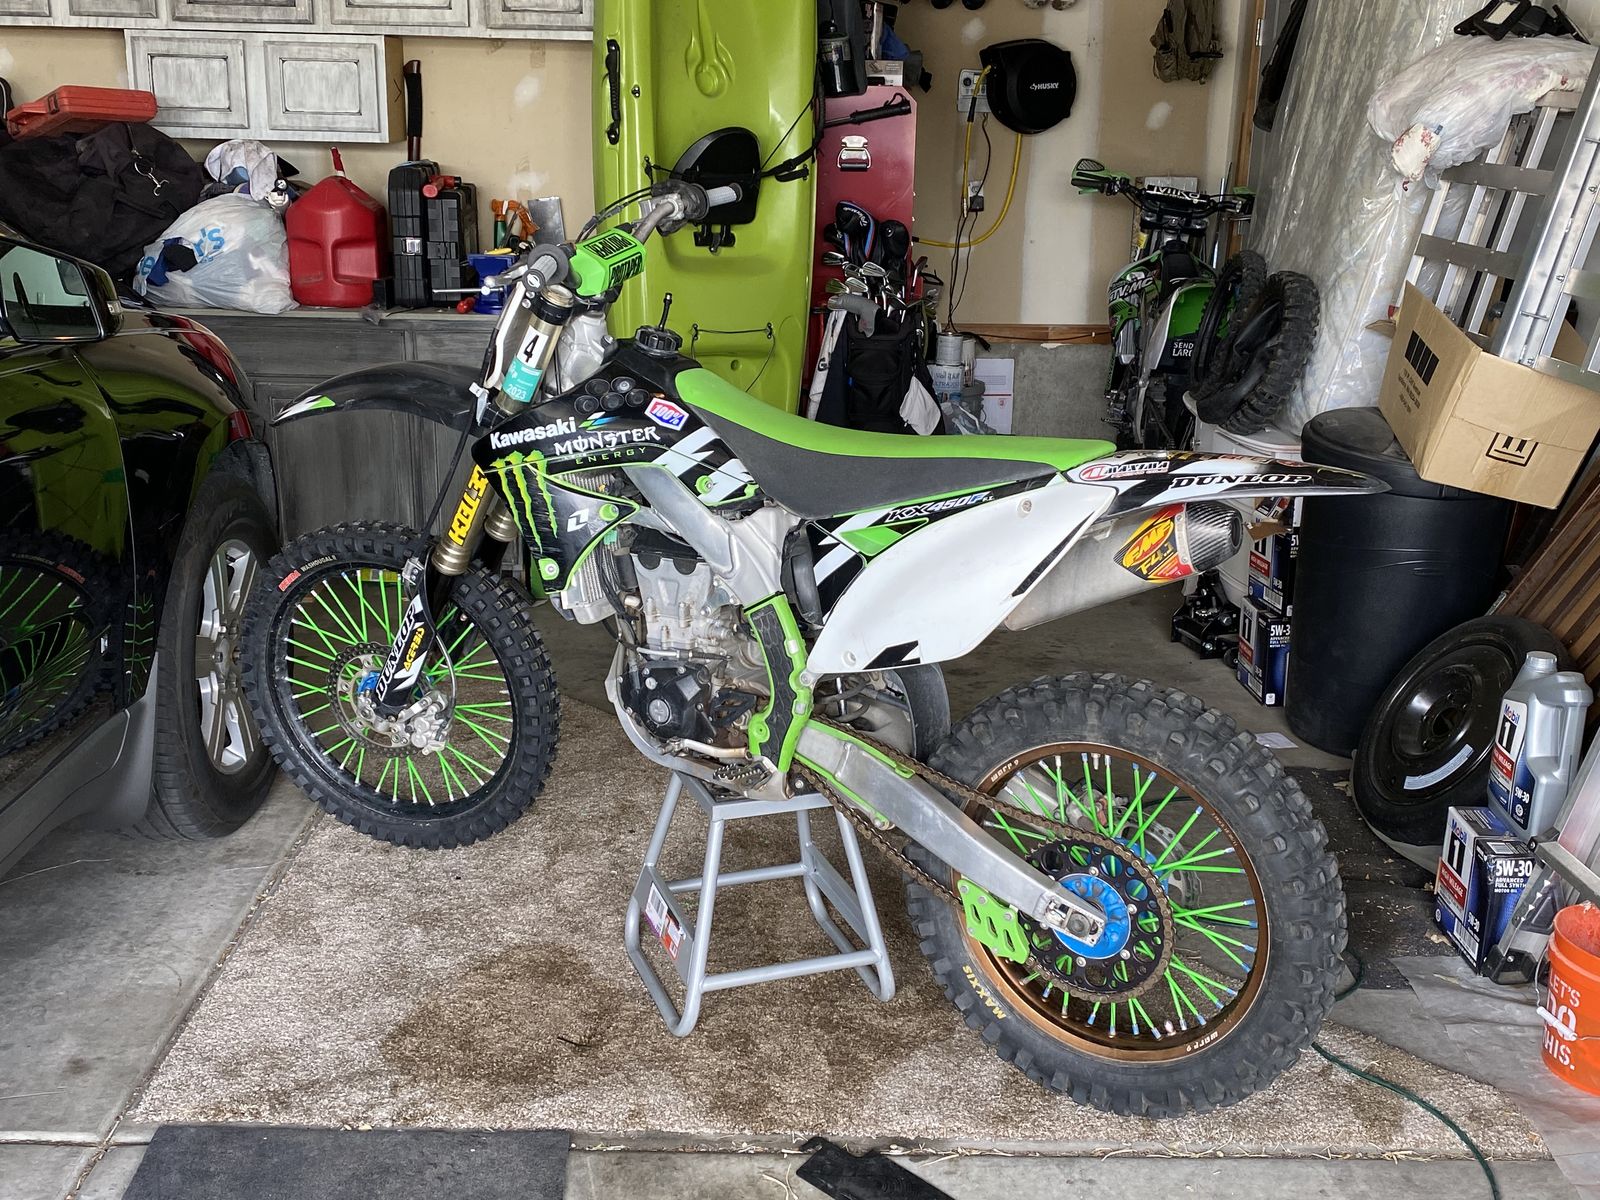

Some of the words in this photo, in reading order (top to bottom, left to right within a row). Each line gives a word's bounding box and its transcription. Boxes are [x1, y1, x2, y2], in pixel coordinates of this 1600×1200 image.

[1037, 82, 1059, 90] HUSKY
[523, 334, 540, 363] 4
[1173, 341, 1194, 349] SEND
[507, 384, 527, 400] 2023
[652, 403, 684, 426] 100%
[490, 416, 577, 450] Kawasaki
[553, 425, 662, 456] MONSTER
[575, 446, 647, 465] ENERGY
[1169, 473, 1313, 490] DUNLOP
[884, 490, 991, 523] KX450F
[1123, 519, 1174, 568] FMF
[1270, 624, 1291, 637] 5W-3
[375, 603, 415, 702] DUNLOP
[403, 627, 425, 672] ACERBIS
[1503, 703, 1521, 725] Mobil
[1502, 720, 1511, 750] 1
[1514, 786, 1531, 804] 5W-30
[1451, 818, 1468, 845] Mobil
[1452, 838, 1461, 871] 1
[1495, 860, 1534, 878] 5W-30
[962, 965, 1007, 1020] MAXXIS
[1549, 967, 1581, 1008] LET'S
[1546, 988, 1577, 1041] DO
